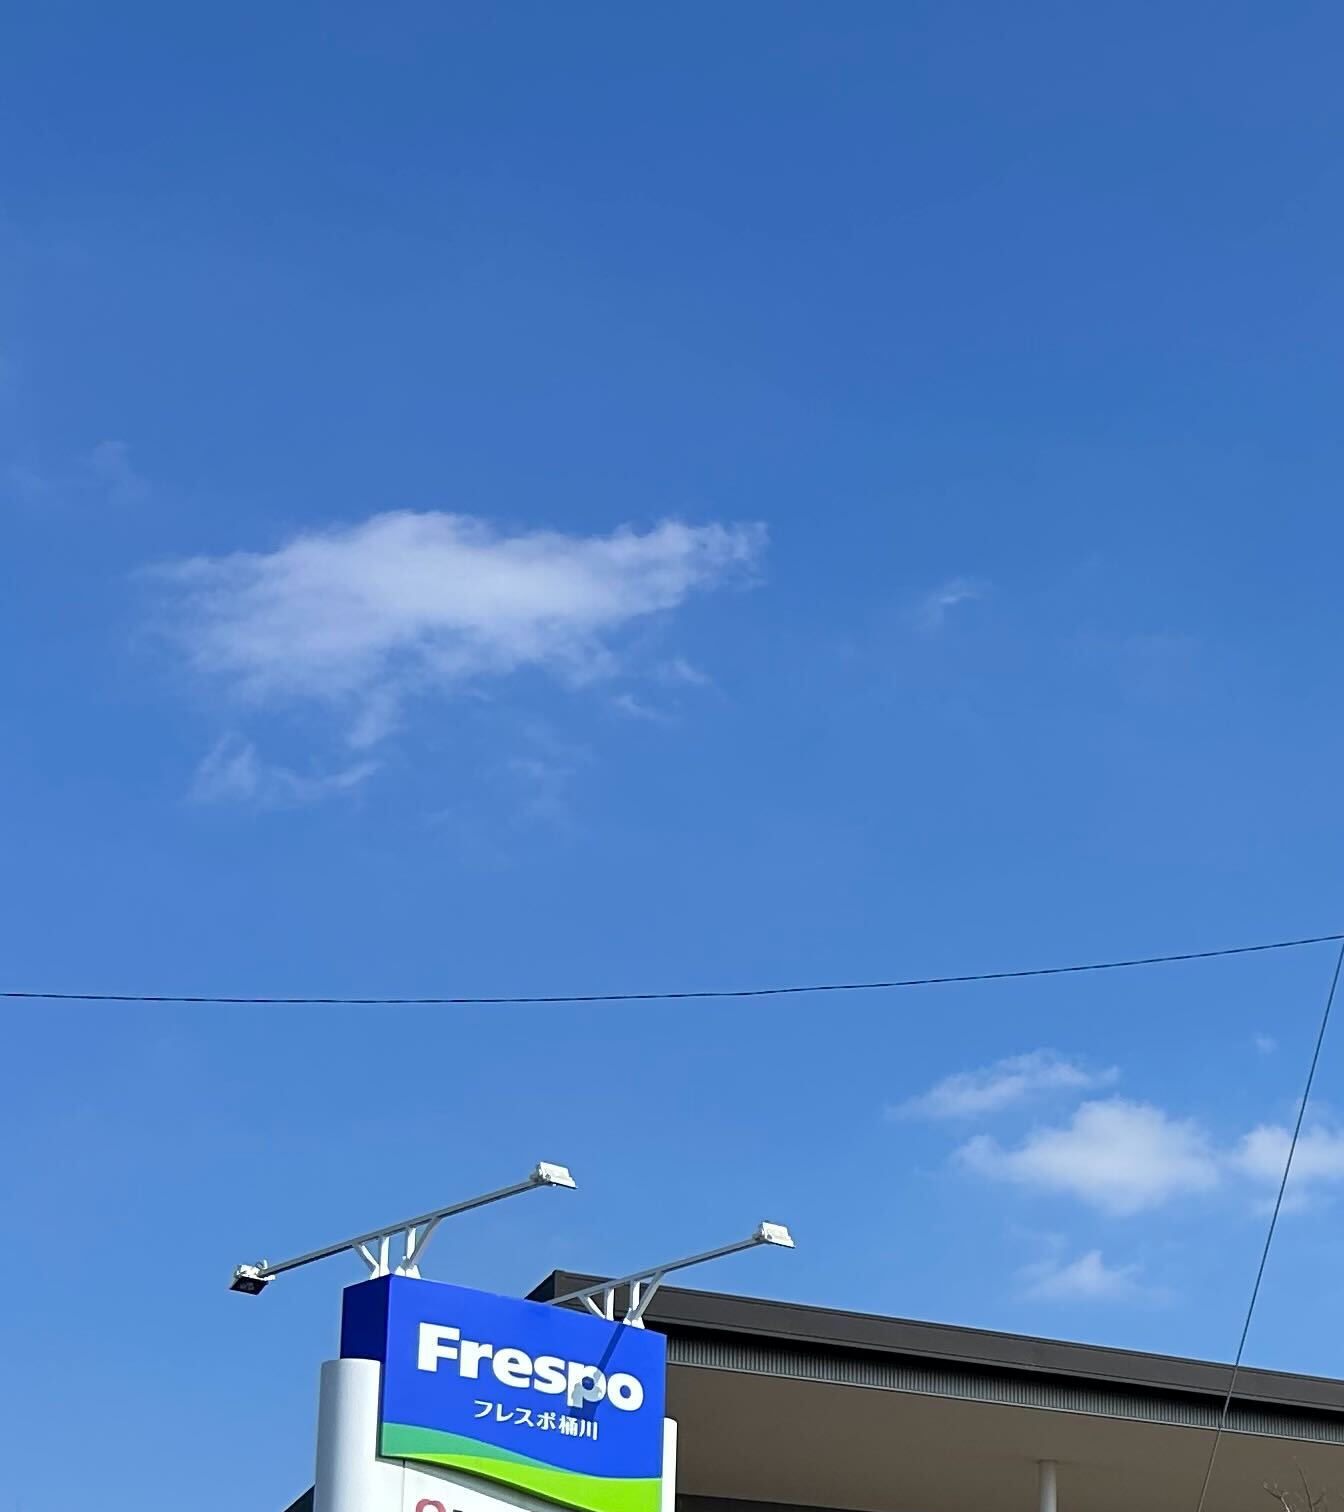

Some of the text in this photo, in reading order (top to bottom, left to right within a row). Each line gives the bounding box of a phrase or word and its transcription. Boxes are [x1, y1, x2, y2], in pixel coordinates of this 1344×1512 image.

[417, 1322, 644, 1411] Frespo
[473, 1400, 599, 1441] フレスポ桶川
